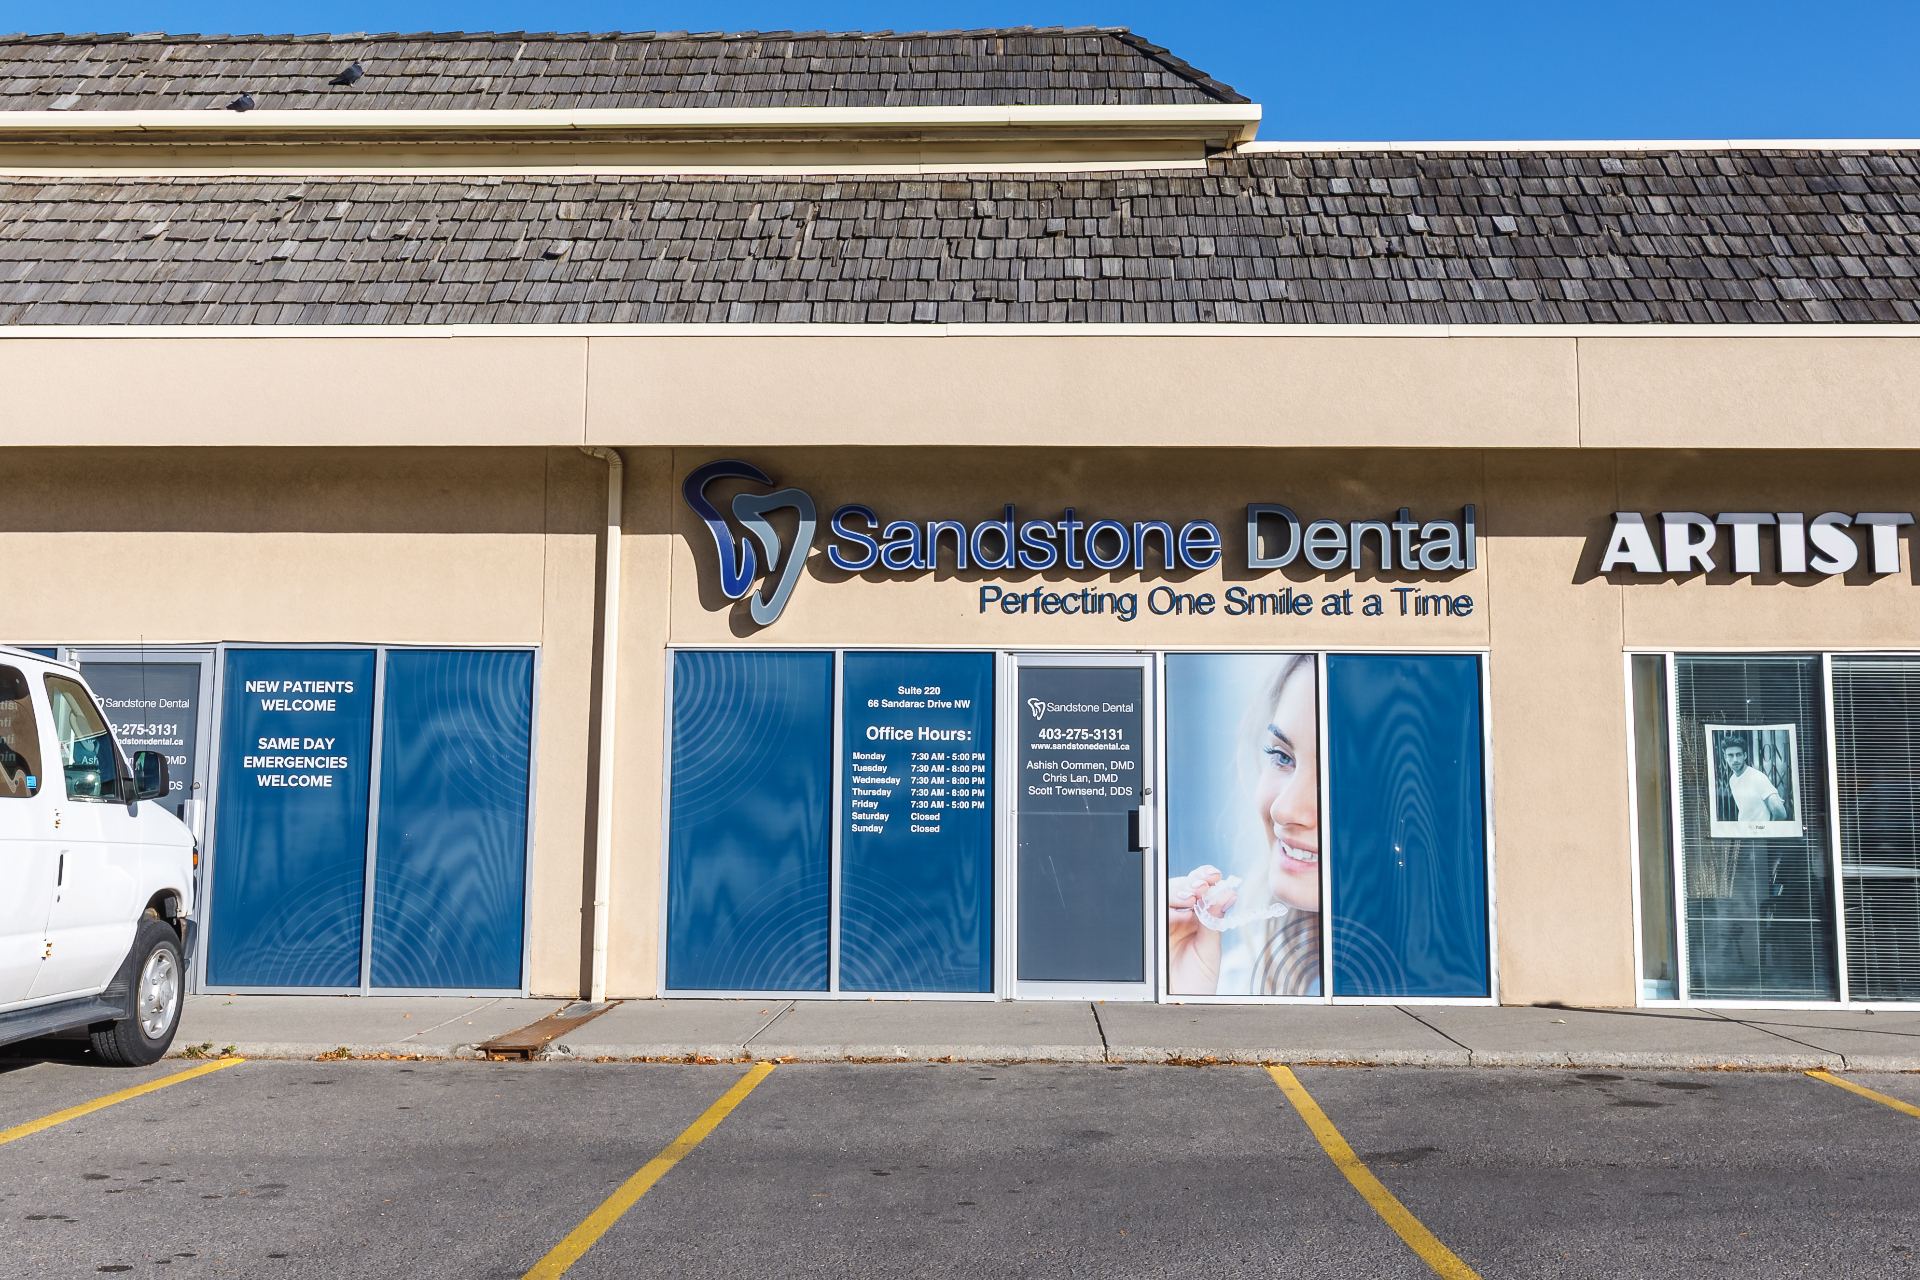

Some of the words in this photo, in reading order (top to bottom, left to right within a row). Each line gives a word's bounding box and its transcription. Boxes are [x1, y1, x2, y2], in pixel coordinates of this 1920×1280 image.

[828, 504, 1222, 570] Sandstone
[1247, 503, 1476, 570] Dental
[1598, 511, 1916, 574] ARTIST
[979, 586, 1138, 621] Perfecting
[1148, 586, 1215, 615] One
[1224, 586, 1313, 615] Smile
[1321, 588, 1353, 615] at
[1362, 594, 1383, 615] a
[1391, 587, 1474, 616] Time
[245, 680, 280, 693] NEW
[283, 681, 354, 693] PATIENTS
[898, 686, 922, 695] Suite
[924, 686, 941, 695] 220
[105, 698, 157, 708] Sandstone
[159, 698, 190, 708] Dental
[261, 699, 336, 711] WELCOME
[867, 699, 879, 708] 66
[881, 699, 925, 708] Sandarac
[927, 699, 952, 708] Drive
[954, 700, 971, 708] NW
[1046, 703, 1100, 712] Sandstone
[1102, 703, 1134, 712] Dental
[866, 726, 914, 740] Office
[918, 726, 972, 741] Hours:
[1038, 728, 1123, 740] 403-275-3131
[258, 737, 300, 750] SAME
[303, 738, 335, 750] DAY
[1031, 742, 1130, 750] www.sandstonedental.ca
[852, 752, 886, 762] Monday
[911, 752, 929, 760] 7:30
[931, 752, 945, 760] AM
[951, 752, 969, 760] 5:00
[971, 752, 985, 760] PM
[243, 756, 348, 769] EMERGENCIES
[1026, 760, 1058, 769] Ashish
[1061, 760, 1108, 771] Oommen,
[1110, 761, 1134, 770] DMD
[852, 764, 888, 773] Tuesday
[911, 765, 929, 773] 7:30
[931, 765, 945, 773] AM
[951, 765, 969, 773] 8:00
[971, 765, 985, 773] PM
[257, 775, 332, 787] WELCOME
[852, 776, 901, 785] Wednesday
[911, 777, 929, 785] 7:30
[931, 777, 945, 785] AM
[951, 777, 969, 785] 8:00
[971, 777, 985, 785] PM
[1042, 773, 1068, 782] Chris
[1070, 774, 1091, 783] Lan,
[1094, 774, 1118, 782] DMD
[169, 782, 183, 790] DS
[852, 788, 892, 797] Thursday
[1028, 786, 1052, 795] Scott
[1055, 786, 1107, 797] Townsend,
[1110, 787, 1133, 796] DDS
[852, 800, 879, 809] Friday
[852, 812, 889, 822] Saturday
[852, 824, 883, 833] Sunday
[910, 825, 940, 833] Closed
